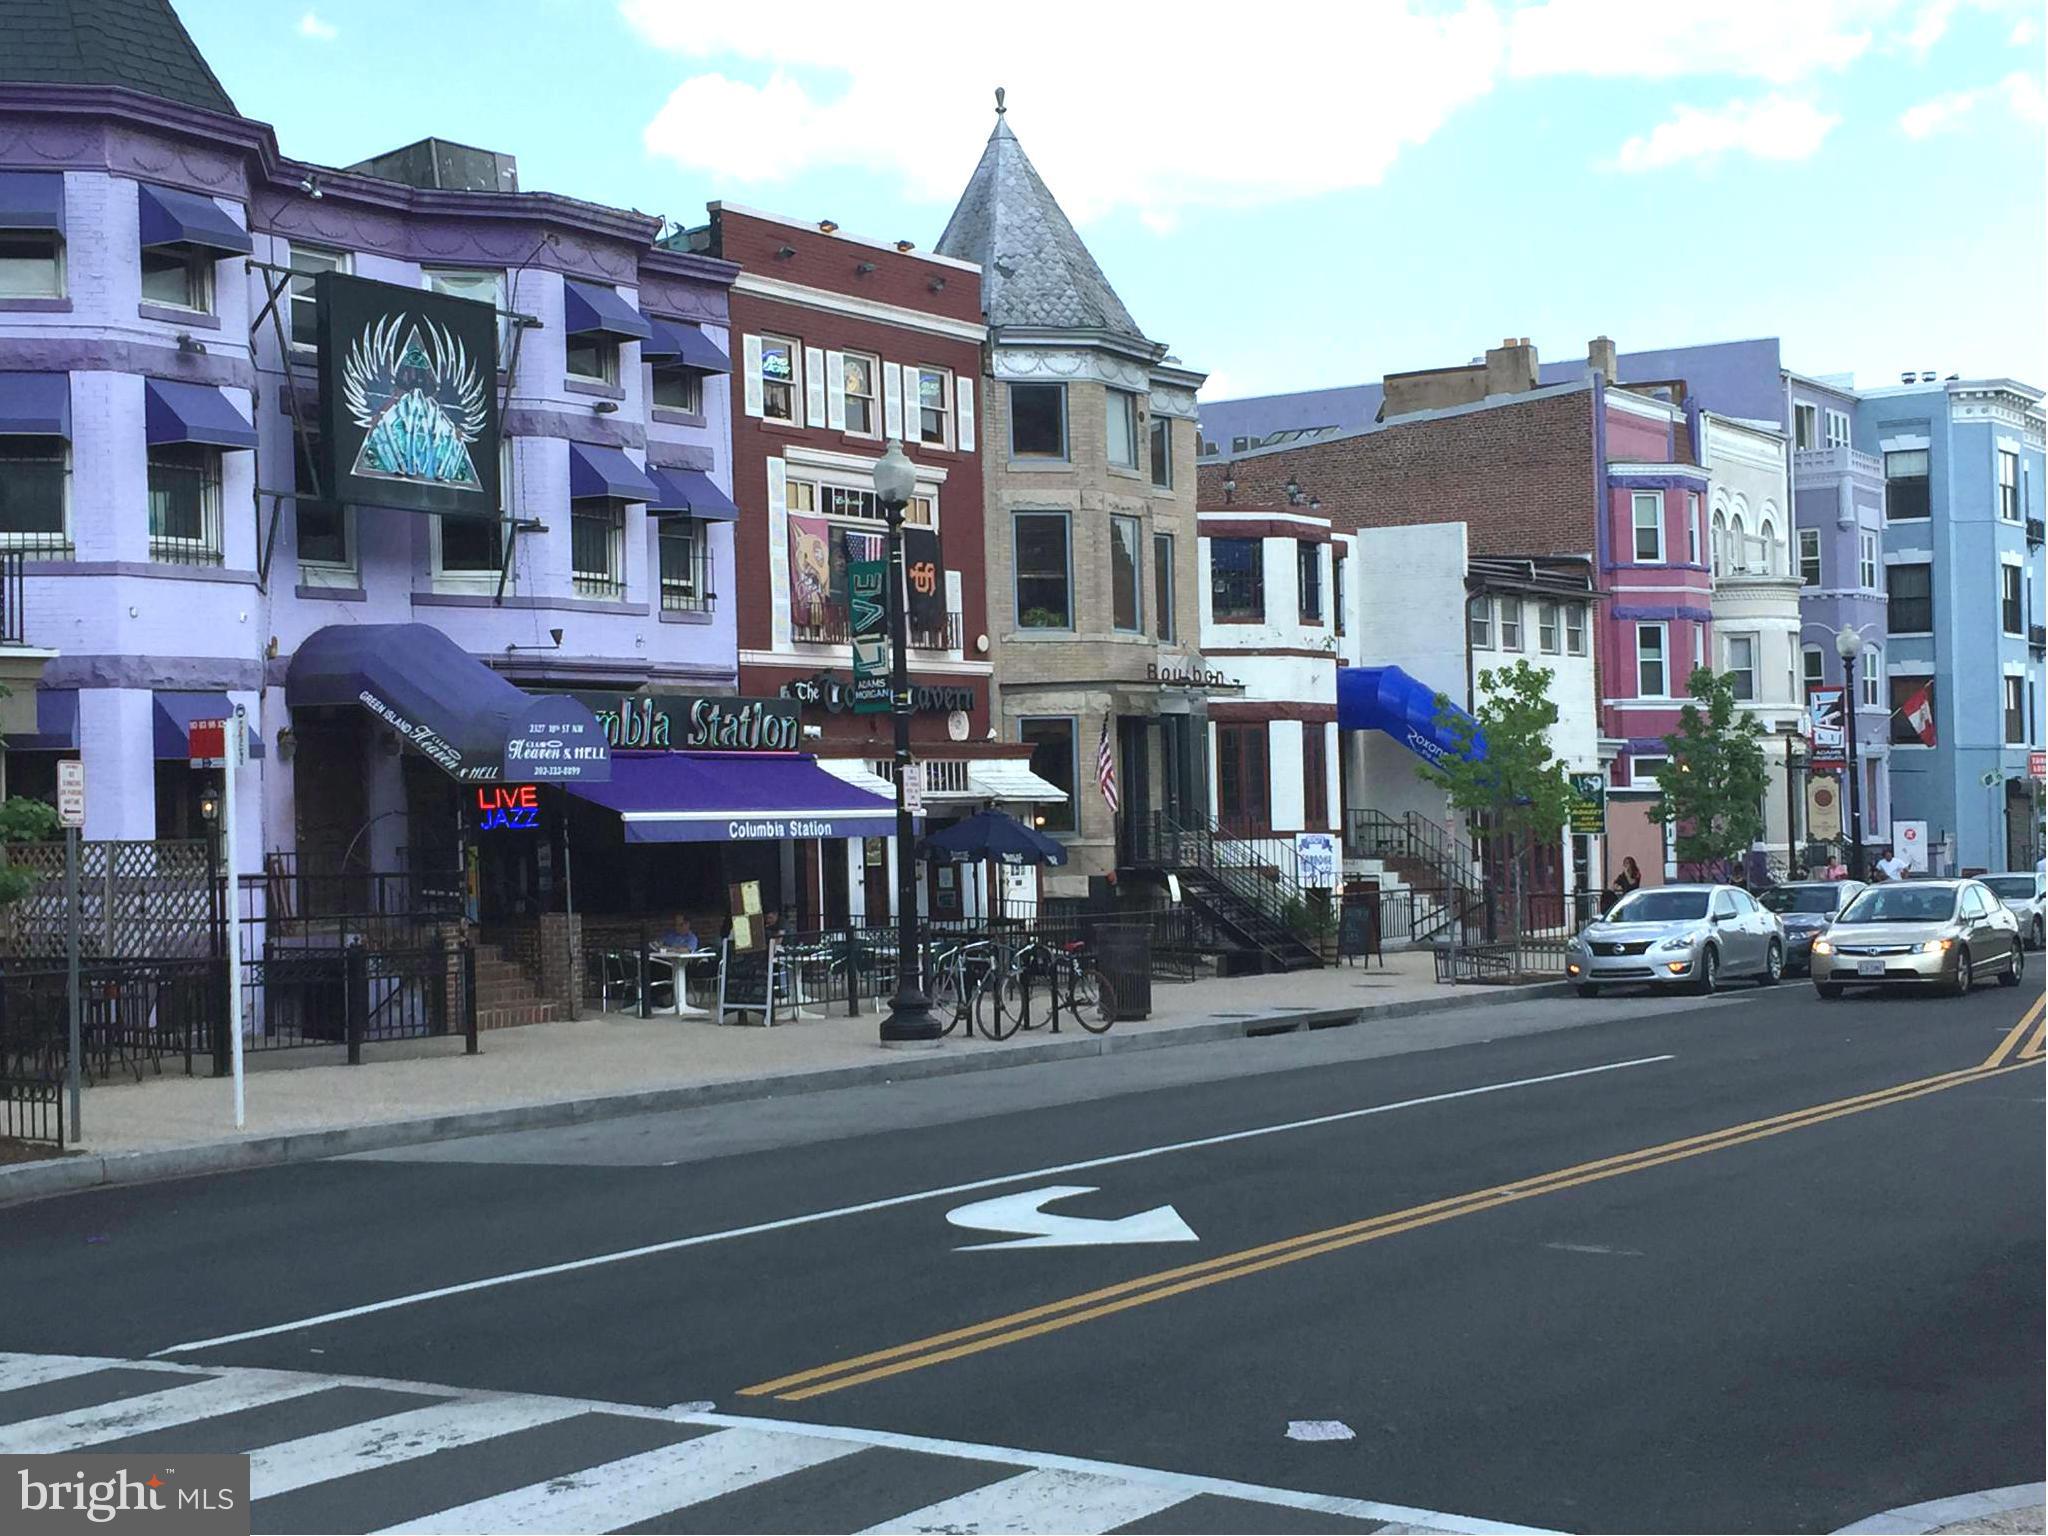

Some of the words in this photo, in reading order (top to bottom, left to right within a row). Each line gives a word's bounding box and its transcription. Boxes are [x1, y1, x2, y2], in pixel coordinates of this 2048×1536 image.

[852, 572, 890, 676] LIVE
[794, 679, 820, 702] The
[854, 689, 890, 700] MORGAN
[857, 679, 886, 690] ADAMS
[359, 690, 386, 715] GREEN
[383, 709, 412, 734] ISLAND
[562, 724, 570, 733] ST
[687, 699, 799, 750] Station
[409, 725, 459, 770] Heaven
[468, 766, 499, 780] HELL
[508, 739, 560, 760] Heaven
[574, 747, 607, 760] HELL
[478, 785, 539, 809] LIVE
[480, 808, 540, 830] JAZZ
[729, 820, 785, 839] Columbia
[790, 820, 832, 838] Station
